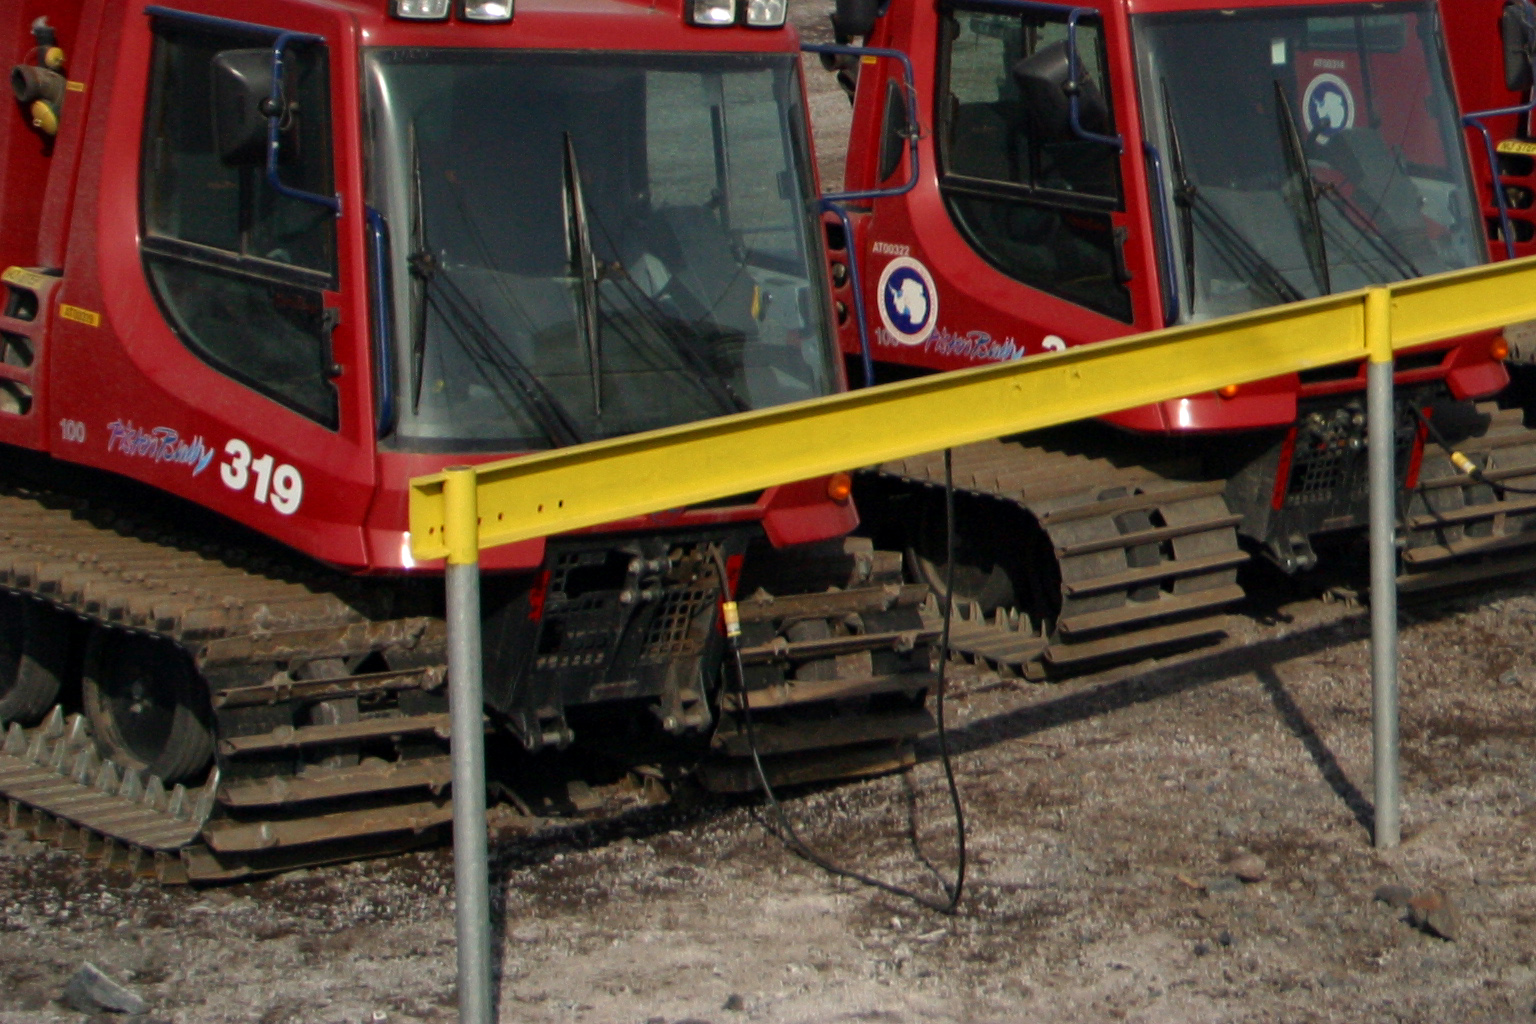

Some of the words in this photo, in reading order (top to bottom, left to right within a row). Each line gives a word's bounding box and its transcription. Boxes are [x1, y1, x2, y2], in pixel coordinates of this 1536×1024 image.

[60, 417, 86, 444] 100
[106, 418, 215, 477] PistenBully
[219, 438, 304, 516] 319
